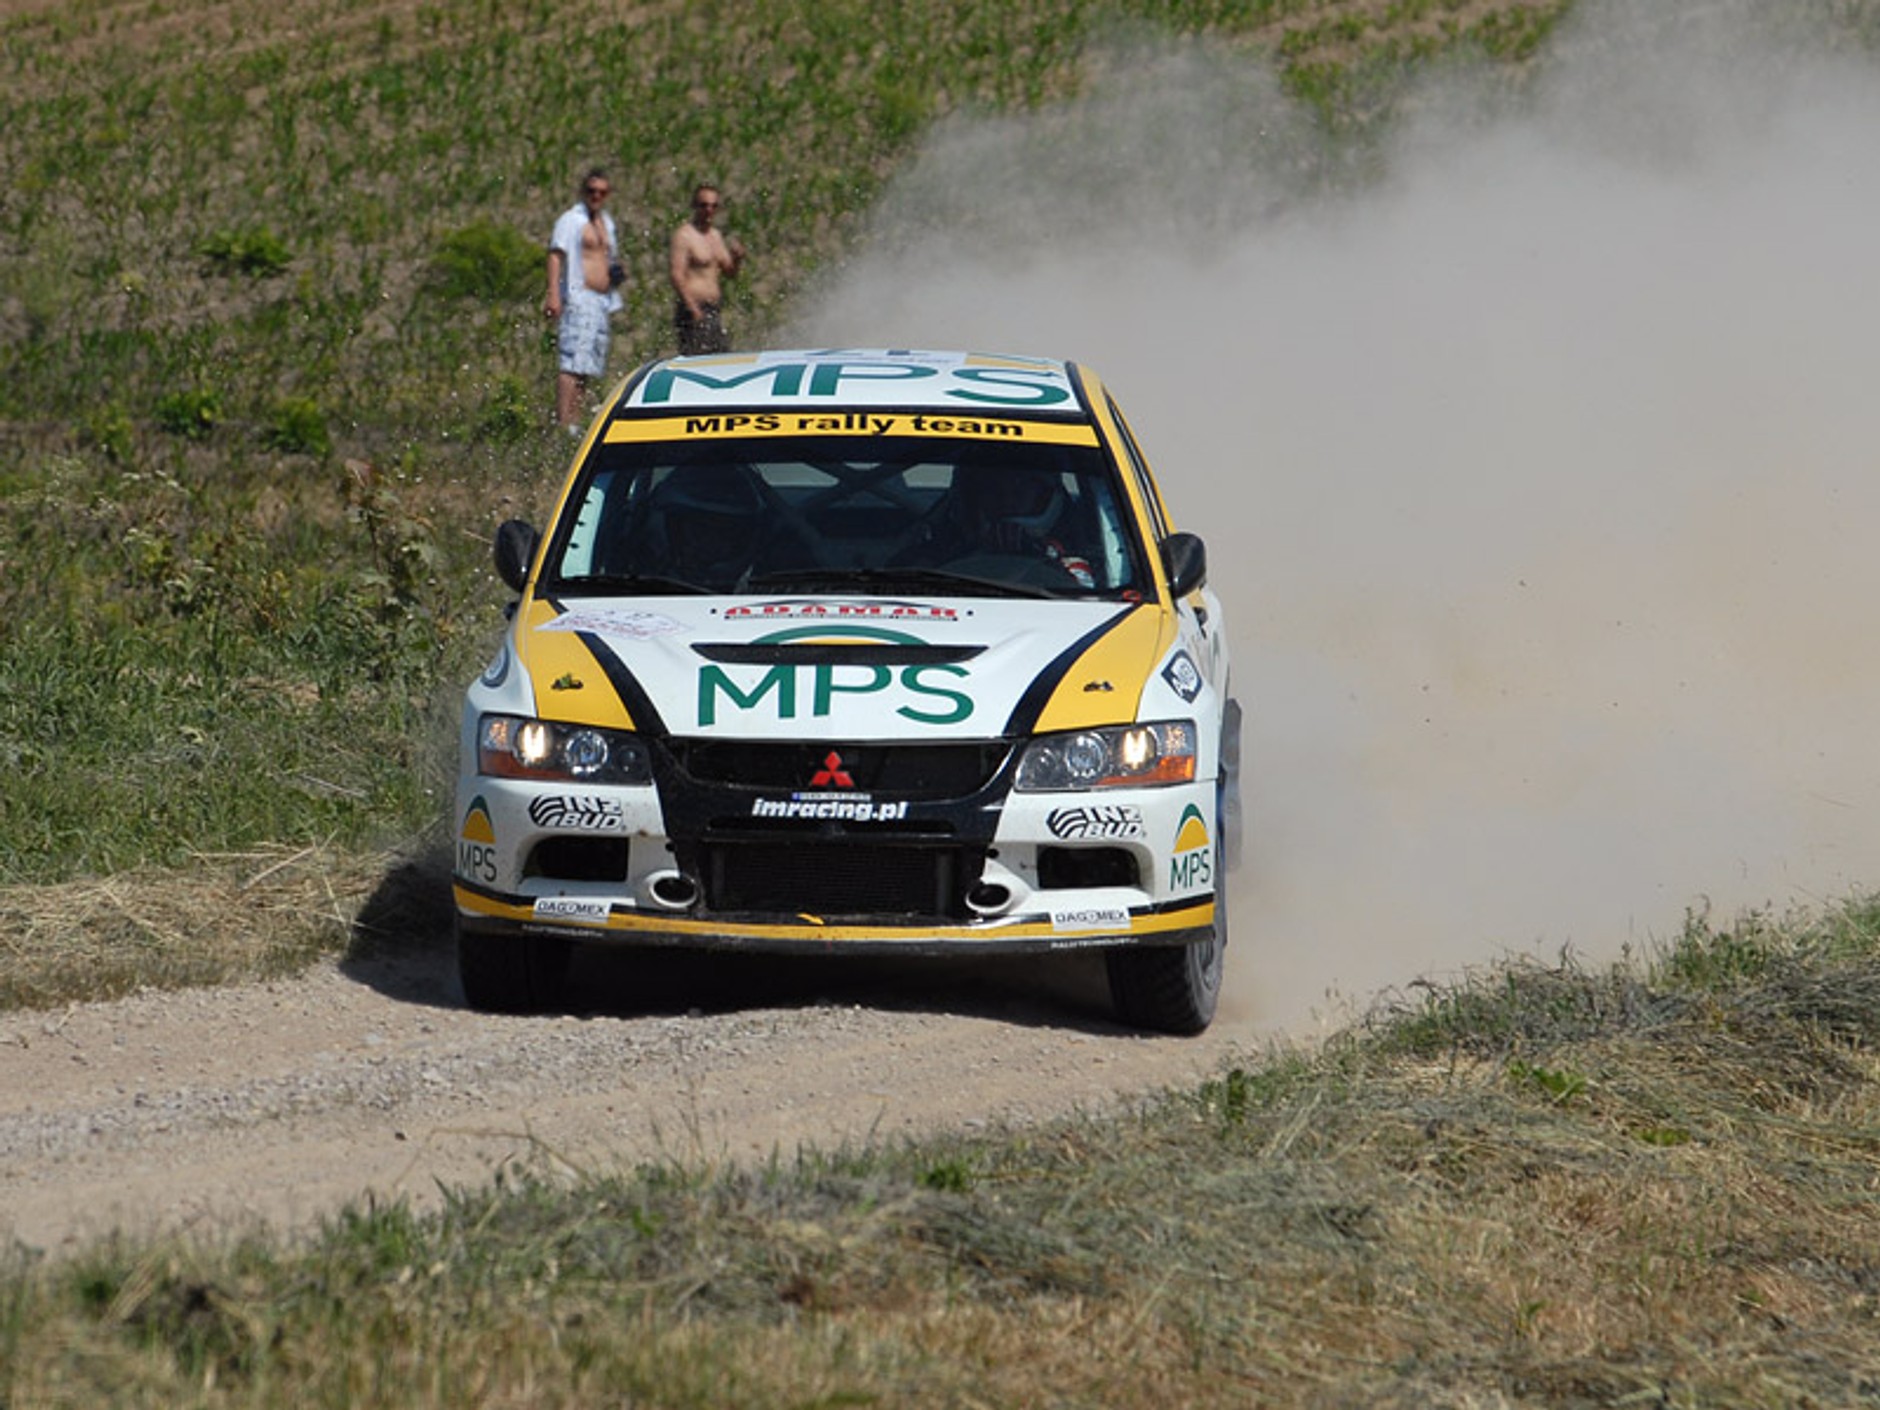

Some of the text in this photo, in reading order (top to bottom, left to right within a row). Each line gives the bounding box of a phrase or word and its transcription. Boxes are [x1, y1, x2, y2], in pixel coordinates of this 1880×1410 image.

[642, 363, 1070, 405] MPS
[686, 413, 1023, 436] MPS rally team
[698, 664, 974, 727] MPS
[558, 811, 622, 830] BUD
[751, 798, 908, 821] imracing.pl
[1081, 821, 1142, 838] BUD
[459, 842, 498, 882] MPS
[1170, 848, 1211, 892] MPS
